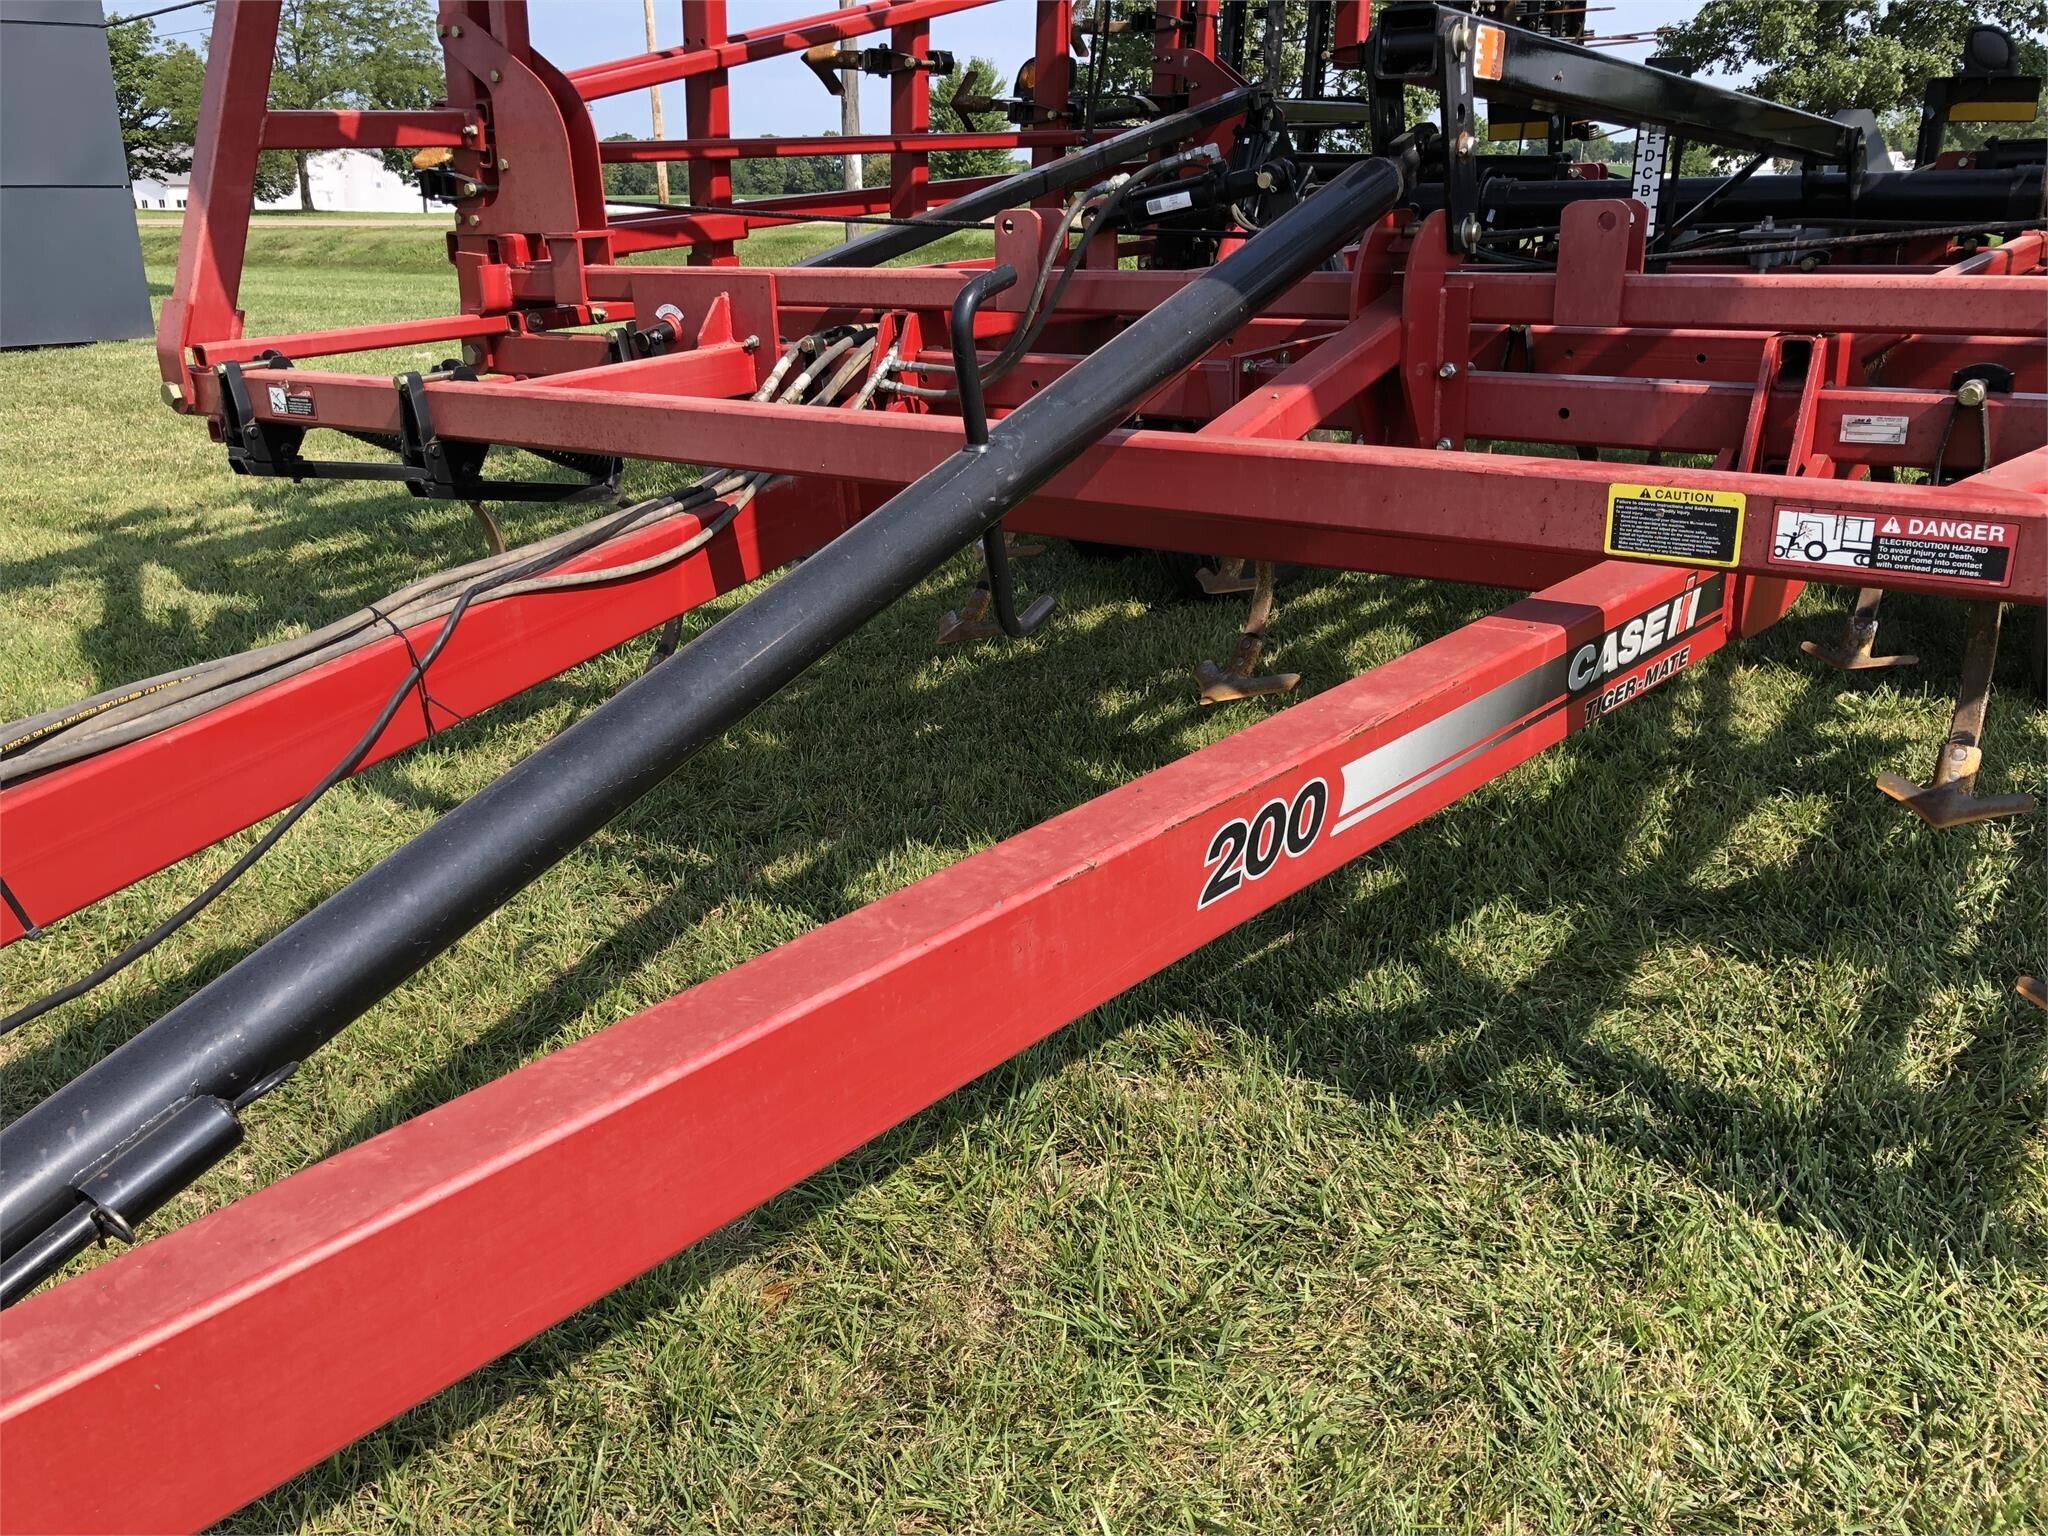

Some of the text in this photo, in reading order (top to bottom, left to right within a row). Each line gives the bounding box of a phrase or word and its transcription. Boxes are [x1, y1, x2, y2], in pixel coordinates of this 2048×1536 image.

[1645, 150, 1655, 162] D
[1642, 167, 1653, 180] C
[1640, 185, 1651, 197] B
[1655, 489, 1714, 503] CAUTION
[1908, 519, 2006, 542] DANGER
[1880, 538, 1988, 554] ELECTROCUTION HAZARD
[1891, 546, 1912, 555] avoid
[1948, 552, 1975, 562] Death,
[1876, 561, 1981, 577] with overhead power lines.
[1877, 553, 1889, 561] DO
[1890, 554, 1909, 563] NOT
[1934, 557, 1950, 566] into
[1951, 560, 1983, 569] contact
[1584, 644, 1691, 723] TIGER-MATE
[1197, 777, 1328, 912] 200
